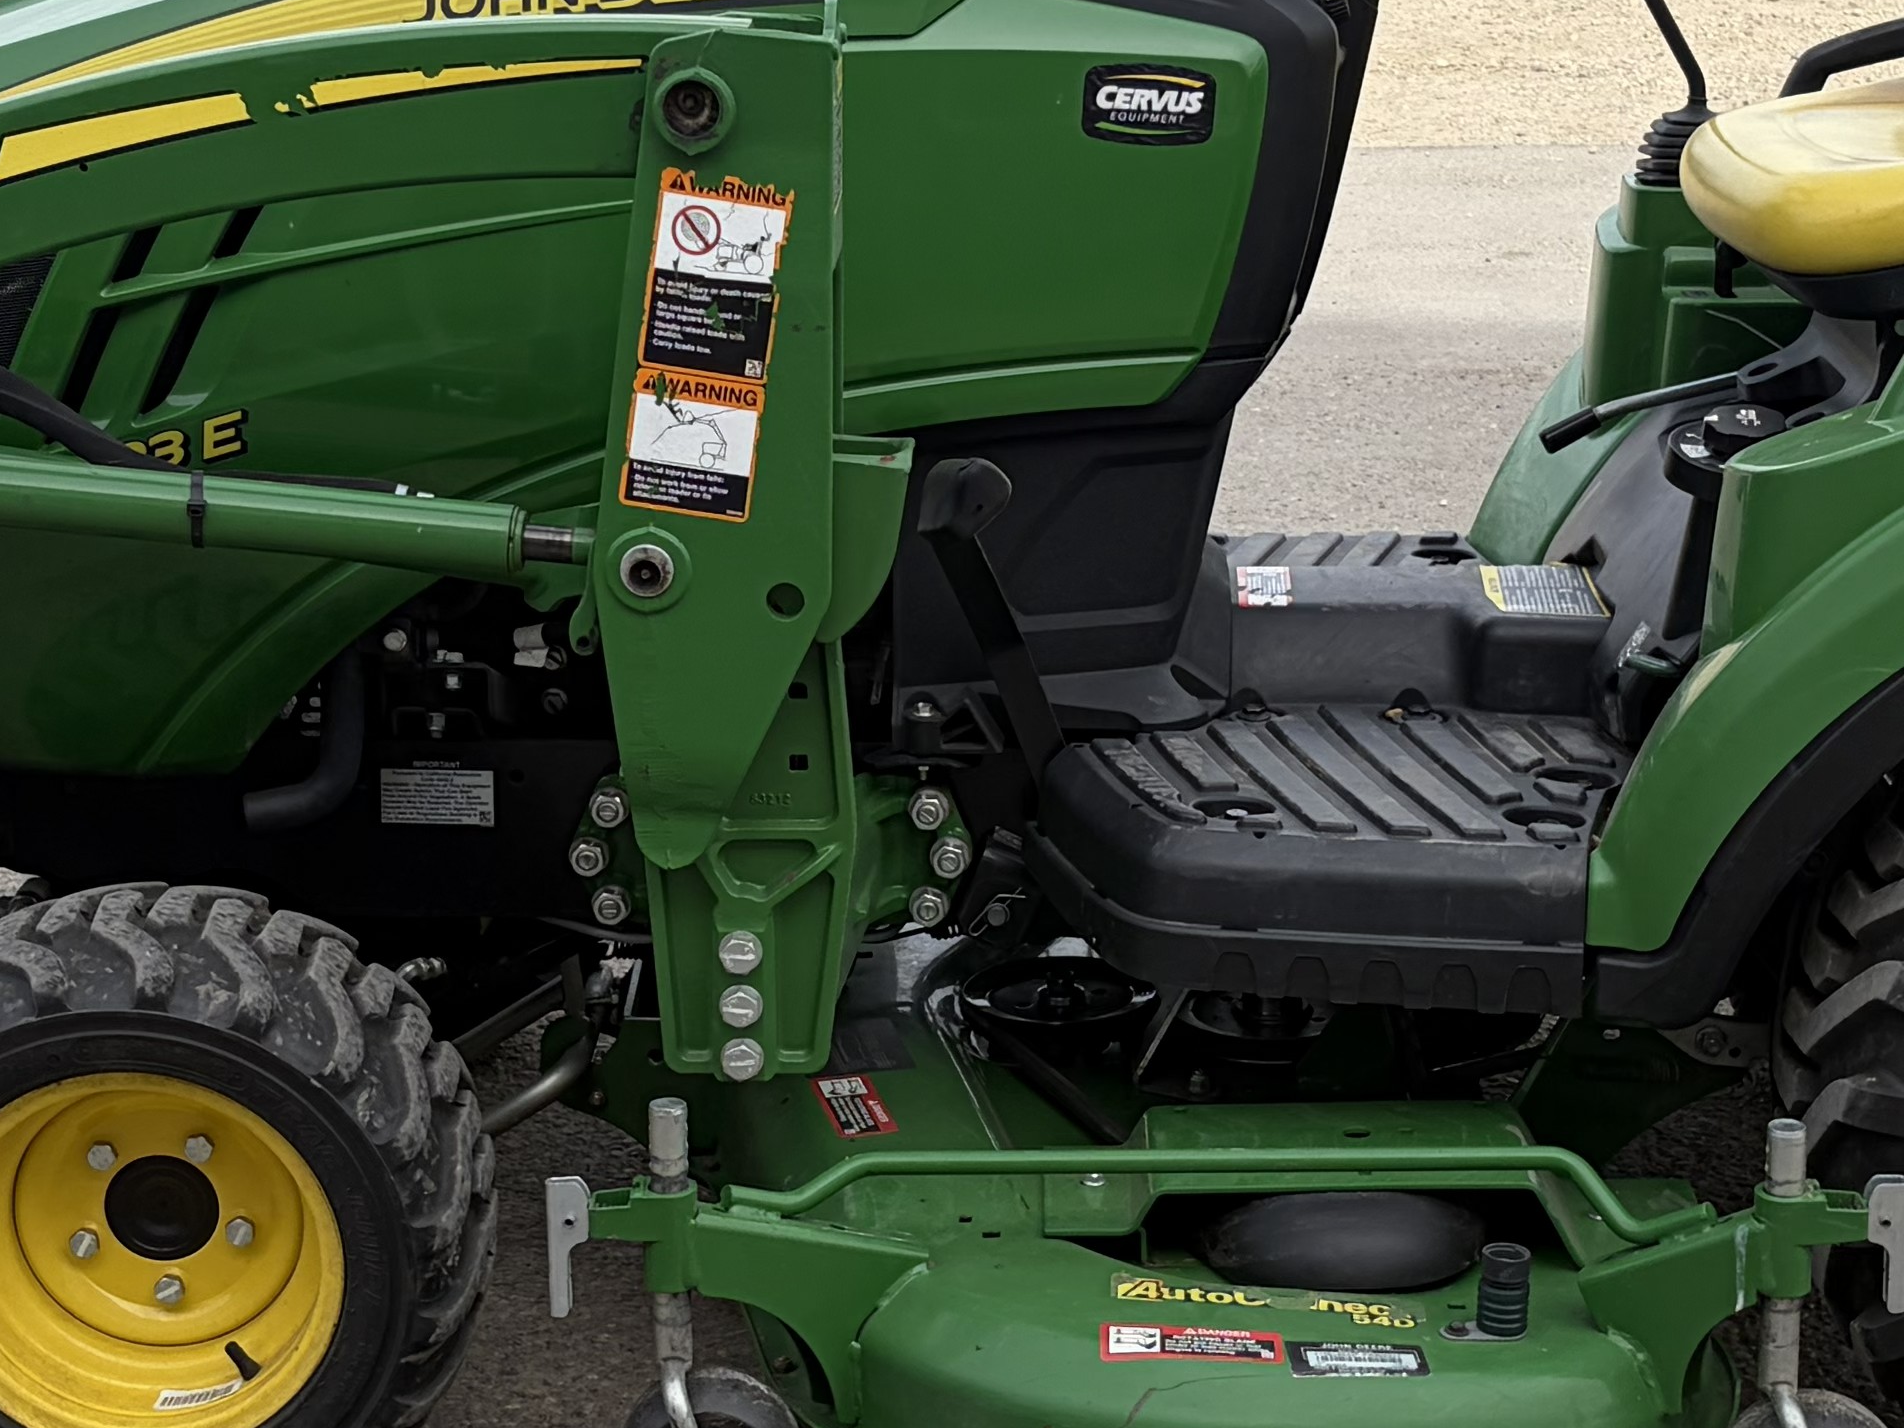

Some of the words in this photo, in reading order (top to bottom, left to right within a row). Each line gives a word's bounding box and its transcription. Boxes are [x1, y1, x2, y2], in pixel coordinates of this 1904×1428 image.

[1095, 85, 1205, 114] CERVUS
[1109, 112, 1185, 125] EQUIPMENT
[666, 377, 758, 407] WARNING
